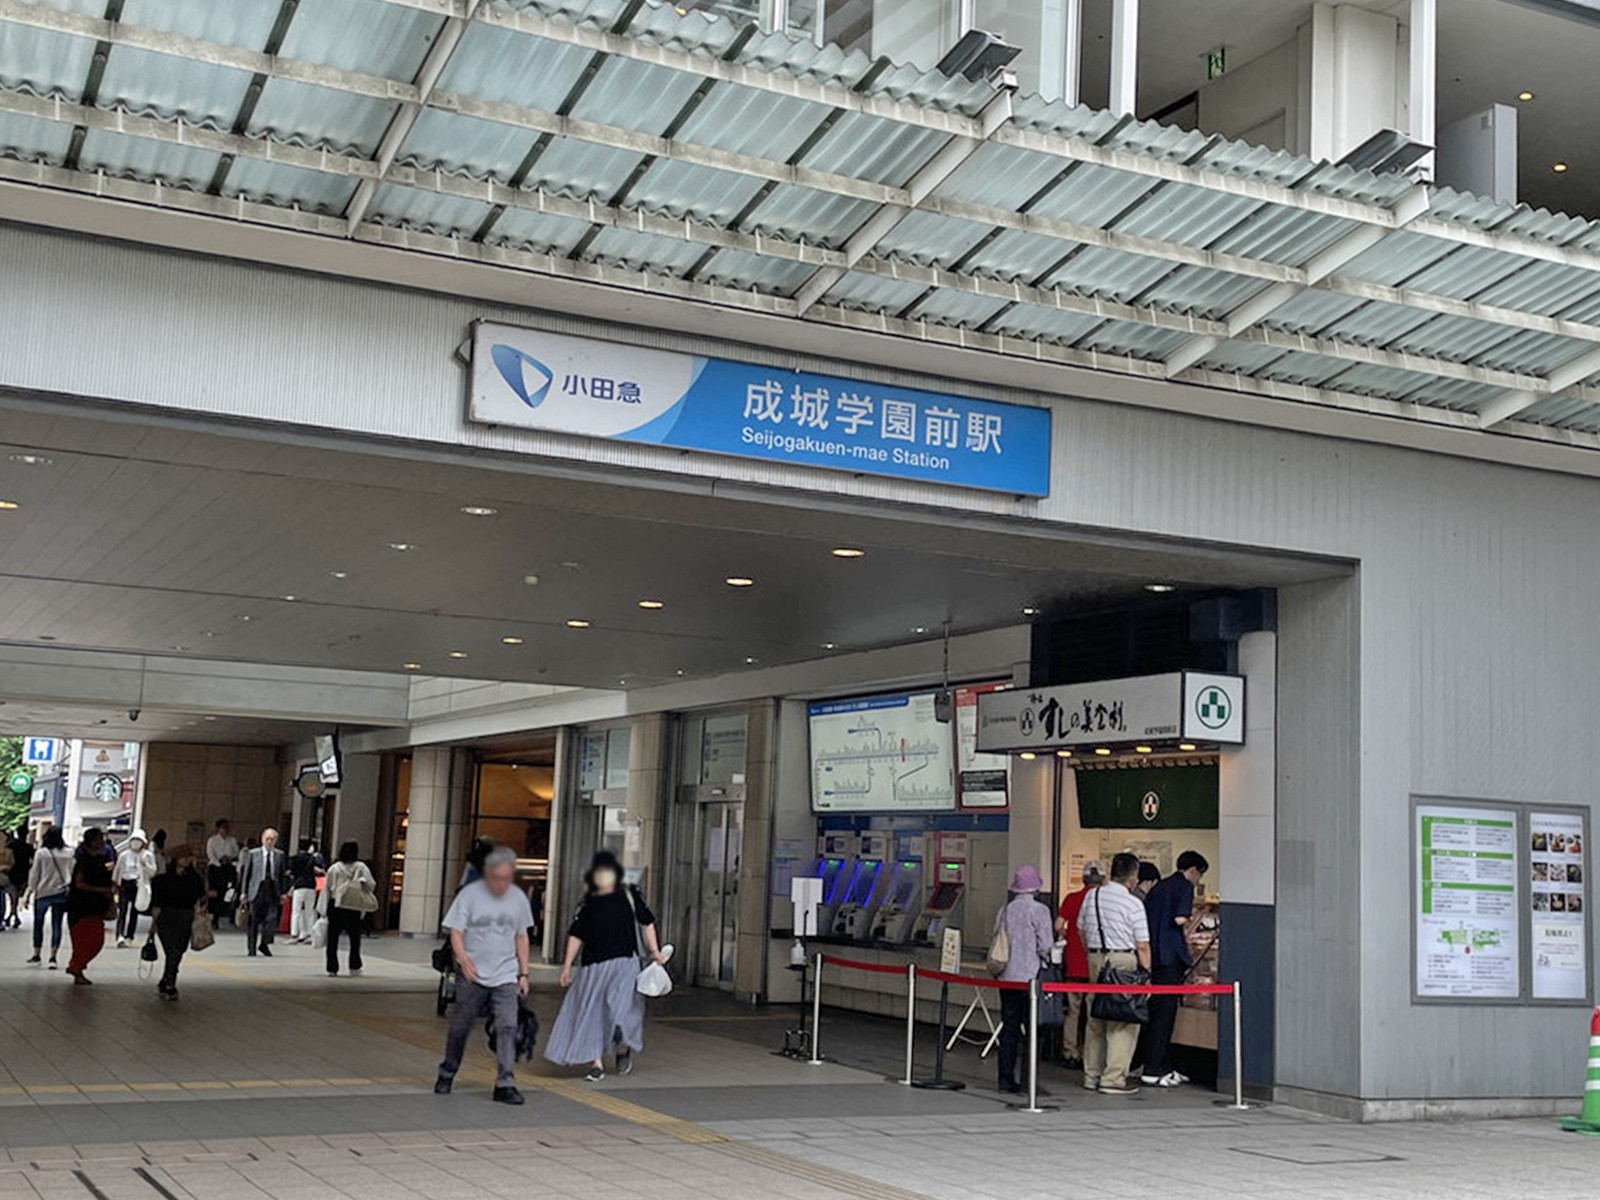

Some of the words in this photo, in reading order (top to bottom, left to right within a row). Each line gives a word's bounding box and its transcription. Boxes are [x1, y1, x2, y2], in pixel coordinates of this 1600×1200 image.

[562, 374, 641, 404] 小田急
[742, 379, 1003, 455] 成城学園前駅
[741, 426, 888, 461] Seijogakuen-mae
[892, 447, 950, 470] Station
